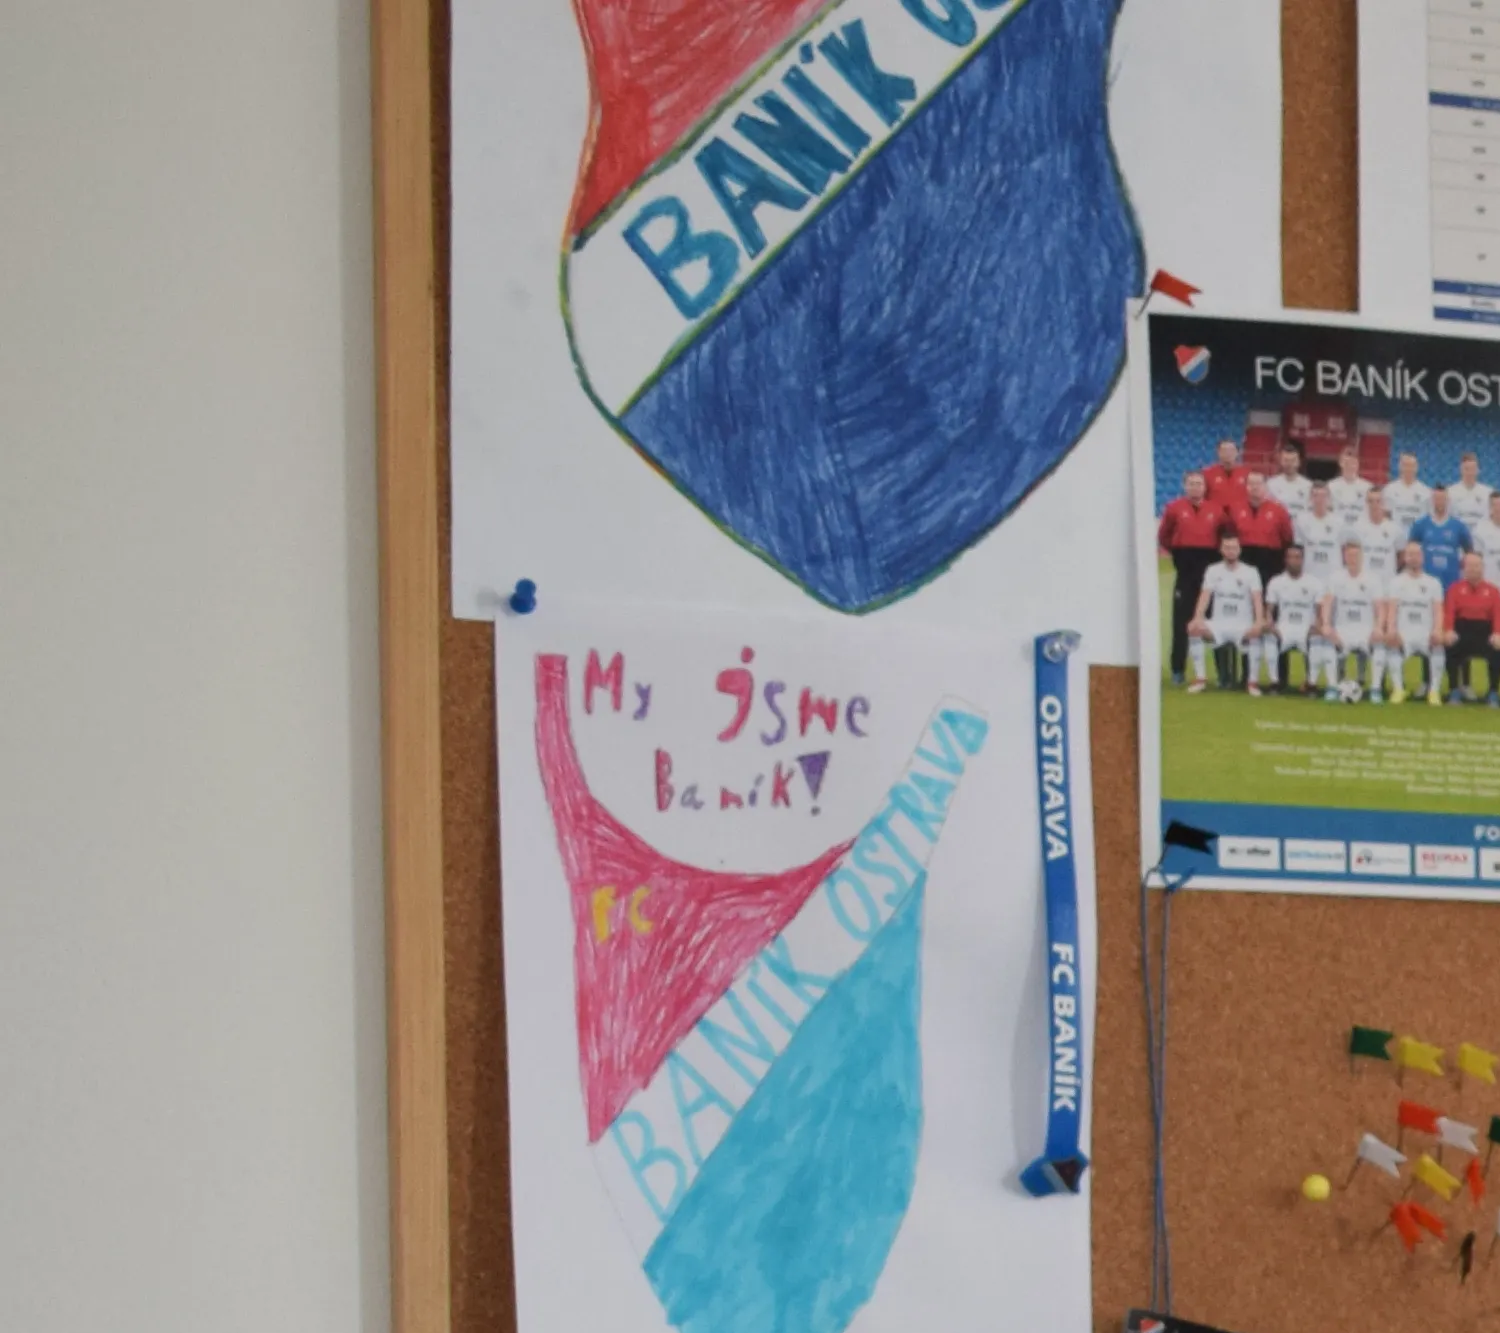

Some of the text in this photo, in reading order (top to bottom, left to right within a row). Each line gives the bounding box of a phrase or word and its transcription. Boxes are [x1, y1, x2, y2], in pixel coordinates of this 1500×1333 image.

[622, 18, 918, 321] BANÍK
[1254, 356, 1305, 393] FC
[1316, 357, 1431, 402] BANÍK
[584, 648, 653, 721] My
[826, 706, 990, 944] OSTRAVA
[1039, 696, 1070, 862] OSTRAVA
[1053, 942, 1082, 1113] FC BANÍK
